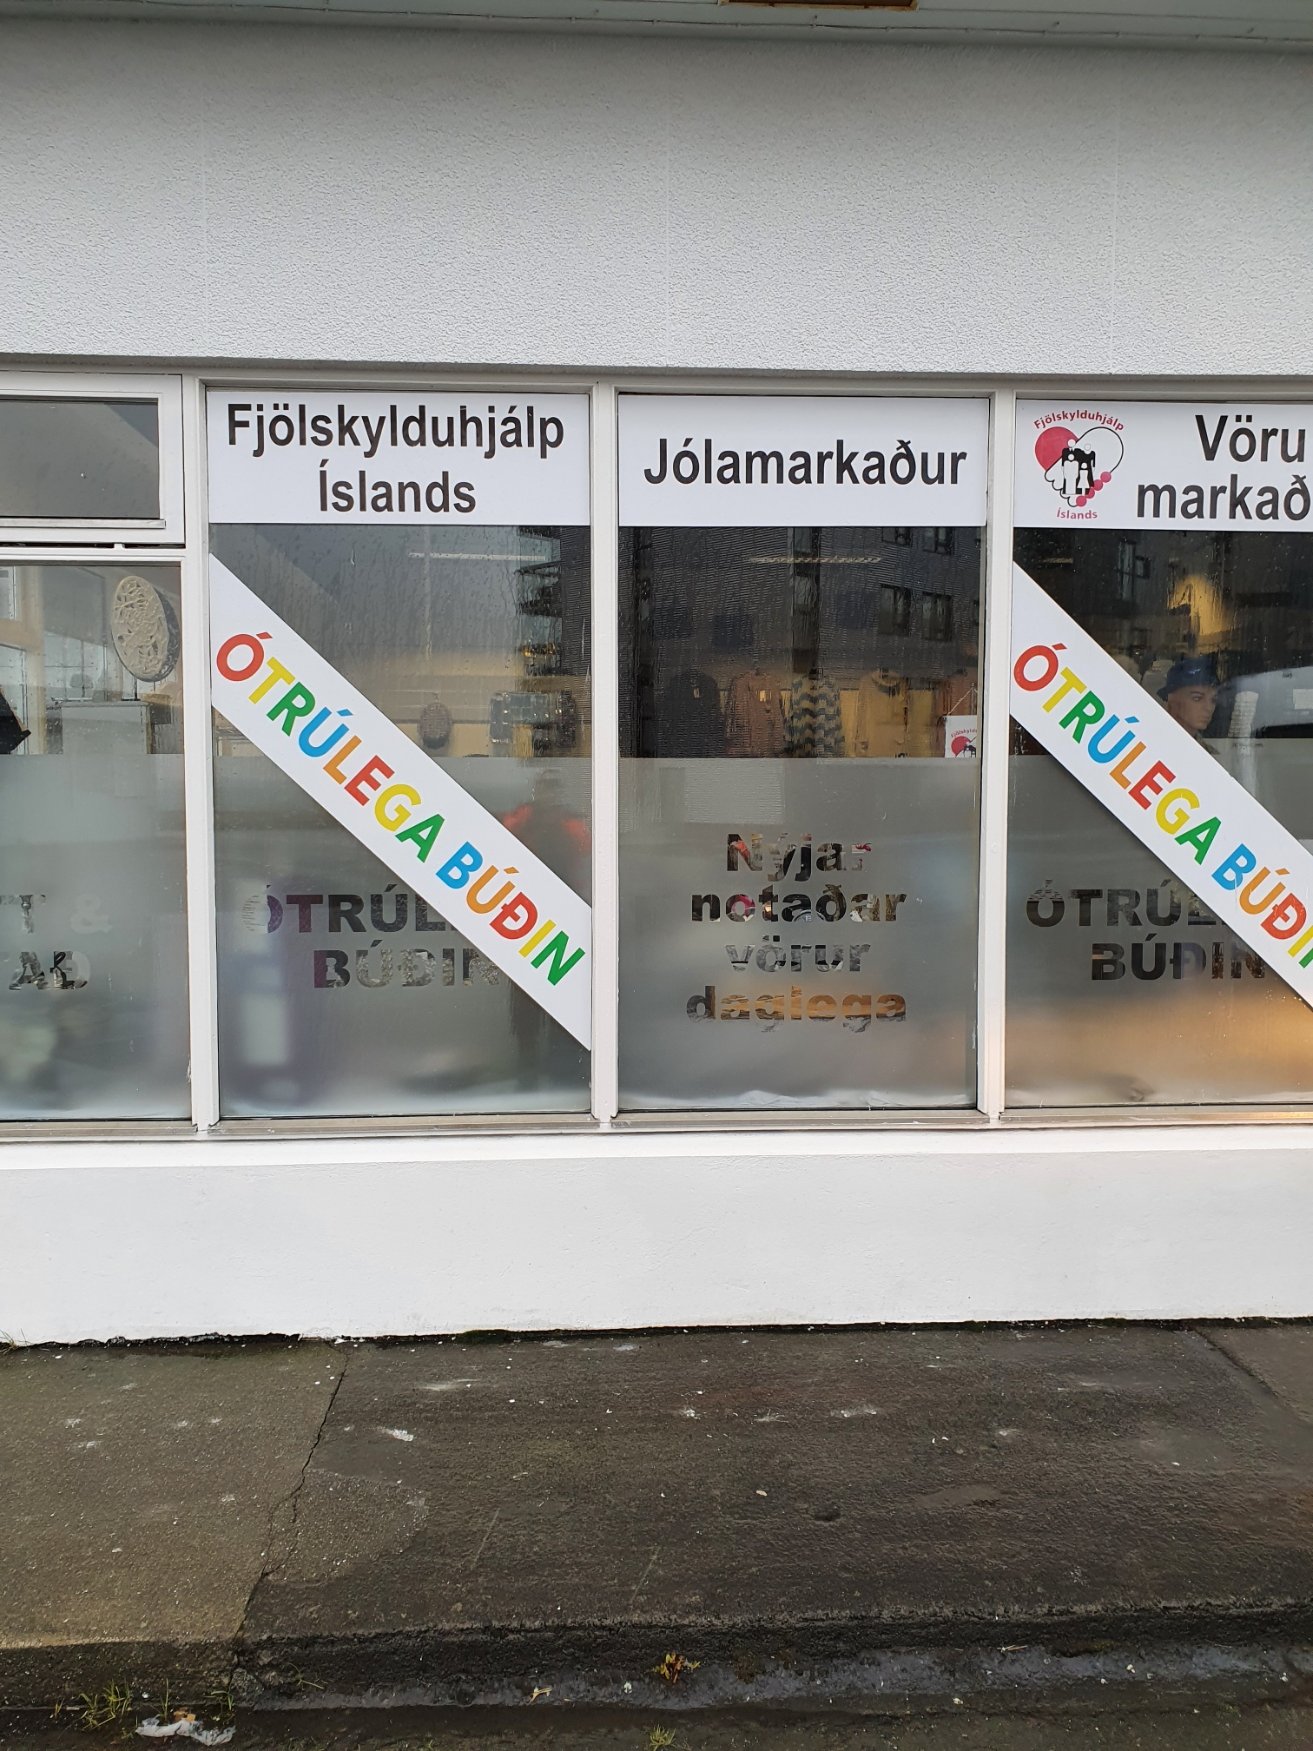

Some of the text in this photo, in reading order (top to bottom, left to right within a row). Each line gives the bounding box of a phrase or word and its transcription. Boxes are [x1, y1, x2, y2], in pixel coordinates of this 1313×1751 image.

[228, 402, 564, 459] Fjölskylduhjálp
[1033, 409, 1124, 431] Fjölskylduhjálp
[1195, 414, 1306, 463] Vöru
[319, 458, 476, 513] Íslands
[644, 437, 968, 485] Jólamarkaður
[1056, 507, 1098, 520] Íslands
[1013, 642, 1222, 866] ÓTRÚLEGA
[216, 630, 586, 987] ÓTRÚLEGA BÚÐIN
[726, 832, 872, 882] Nýjar
[240, 883, 457, 934] ÓTRÚL
[691, 884, 907, 922] notaðar
[1026, 879, 1227, 928] ÓTRÚL
[724, 934, 871, 972] vörur
